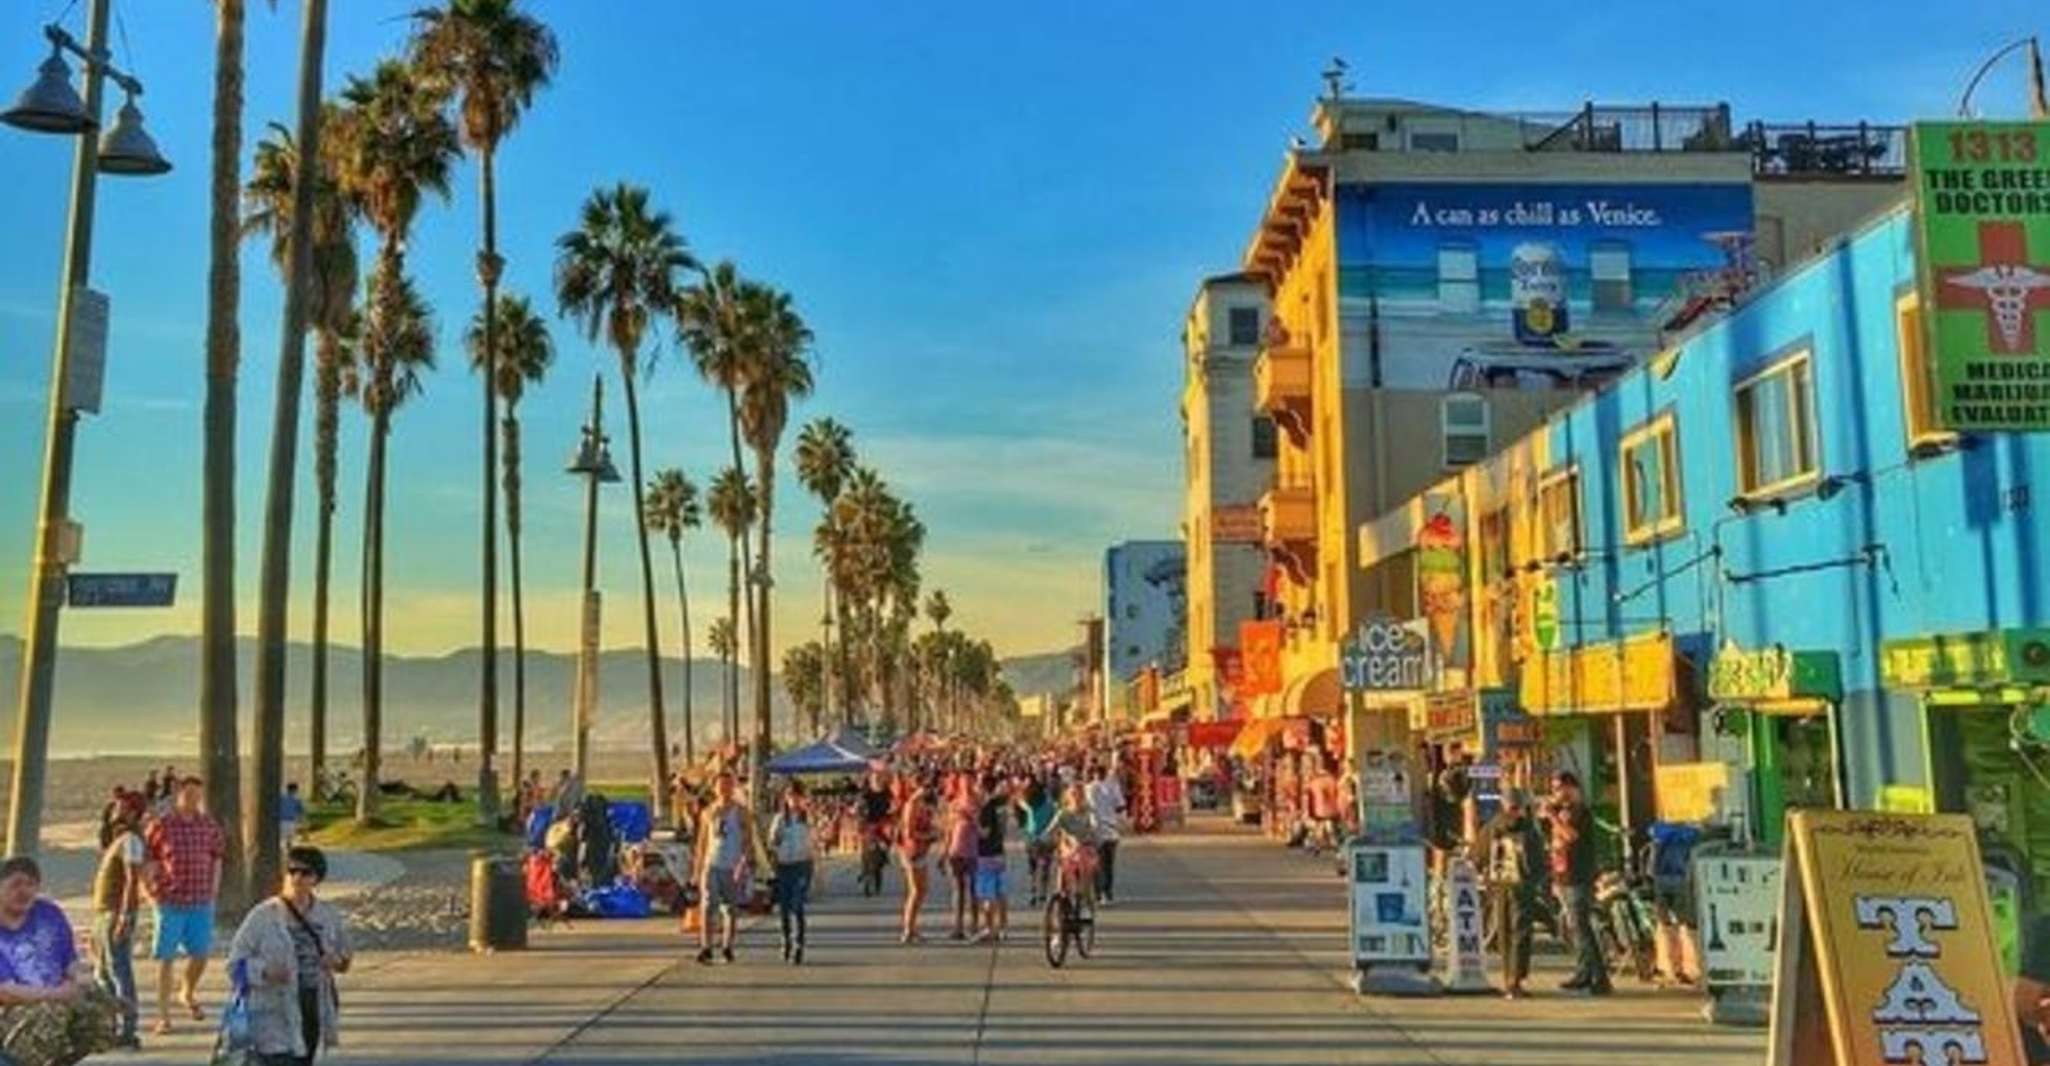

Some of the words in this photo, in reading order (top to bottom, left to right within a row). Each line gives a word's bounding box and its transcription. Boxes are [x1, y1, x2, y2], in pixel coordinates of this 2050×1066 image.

[1948, 130, 2037, 162] 1313
[1926, 170, 1975, 190] THE
[1981, 170, 2050, 190] GREE
[1411, 202, 1432, 225] A
[1435, 207, 1473, 226] can
[1477, 207, 1499, 226] as
[1504, 202, 1554, 226] chill
[1558, 207, 1581, 226] as
[1586, 201, 1663, 226] Venice.
[1358, 620, 1405, 652] ice
[1457, 887, 1479, 954] ATM
